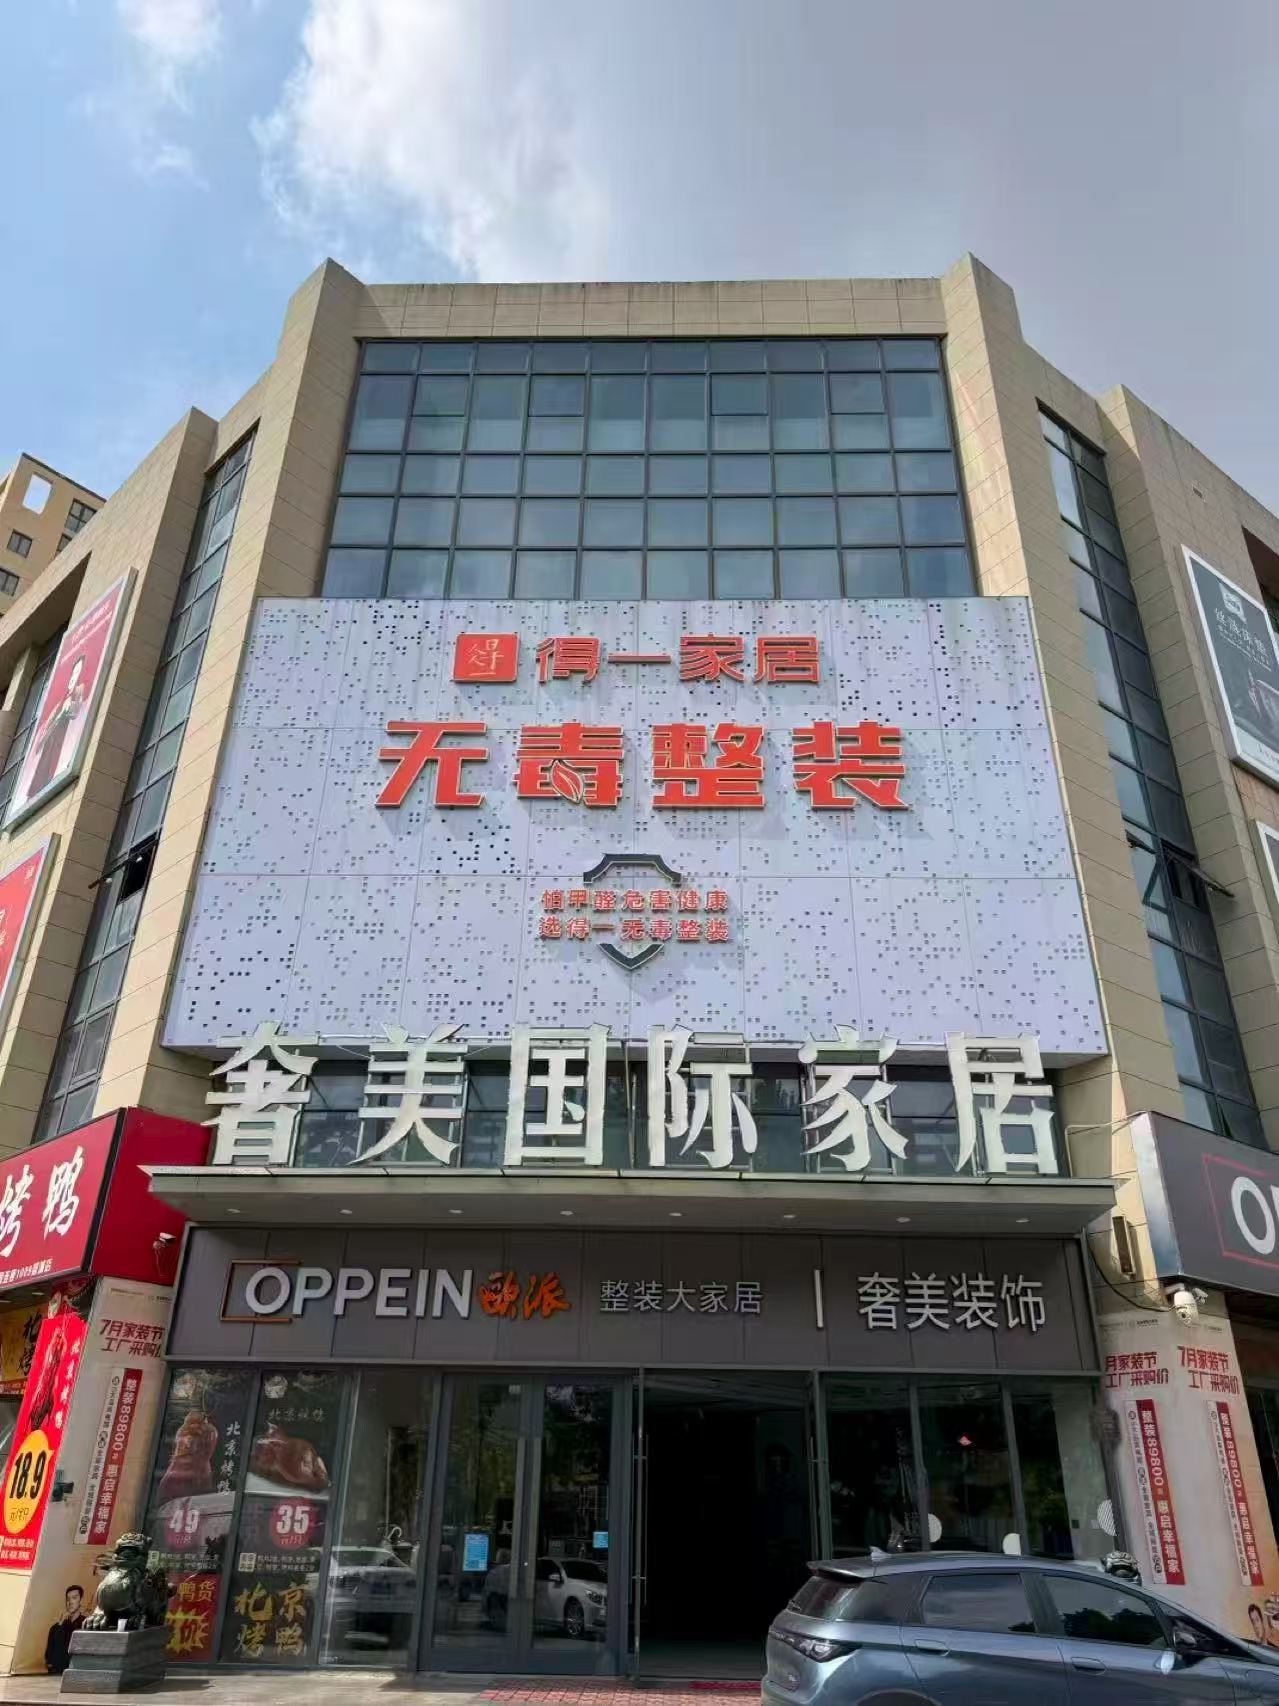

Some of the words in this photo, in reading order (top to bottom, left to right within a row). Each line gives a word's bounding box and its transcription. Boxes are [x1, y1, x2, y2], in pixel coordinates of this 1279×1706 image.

[536, 634, 821, 684] 得一家居
[375, 721, 908, 809] 无毒整装
[541, 889, 729, 912] 怕甲醛危害健康
[538, 916, 730, 943] 选得一无毒整装
[201, 1019, 1059, 1175] 奢美国际家居
[1231, 1176, 1279, 1255] O
[245, 1267, 474, 1319] OPPEIN
[600, 1280, 762, 1314] 整装大家居
[857, 1272, 1046, 1332] 奢美装饰
[99, 1319, 165, 1341] 7月家装节
[1105, 1368, 1169, 1388] 工厂采购价
[1177, 1345, 1229, 1372] 7月家装节
[9, 1450, 46, 1499] 18.9
[169, 1510, 200, 1534] 49
[276, 1504, 310, 1534] 35
